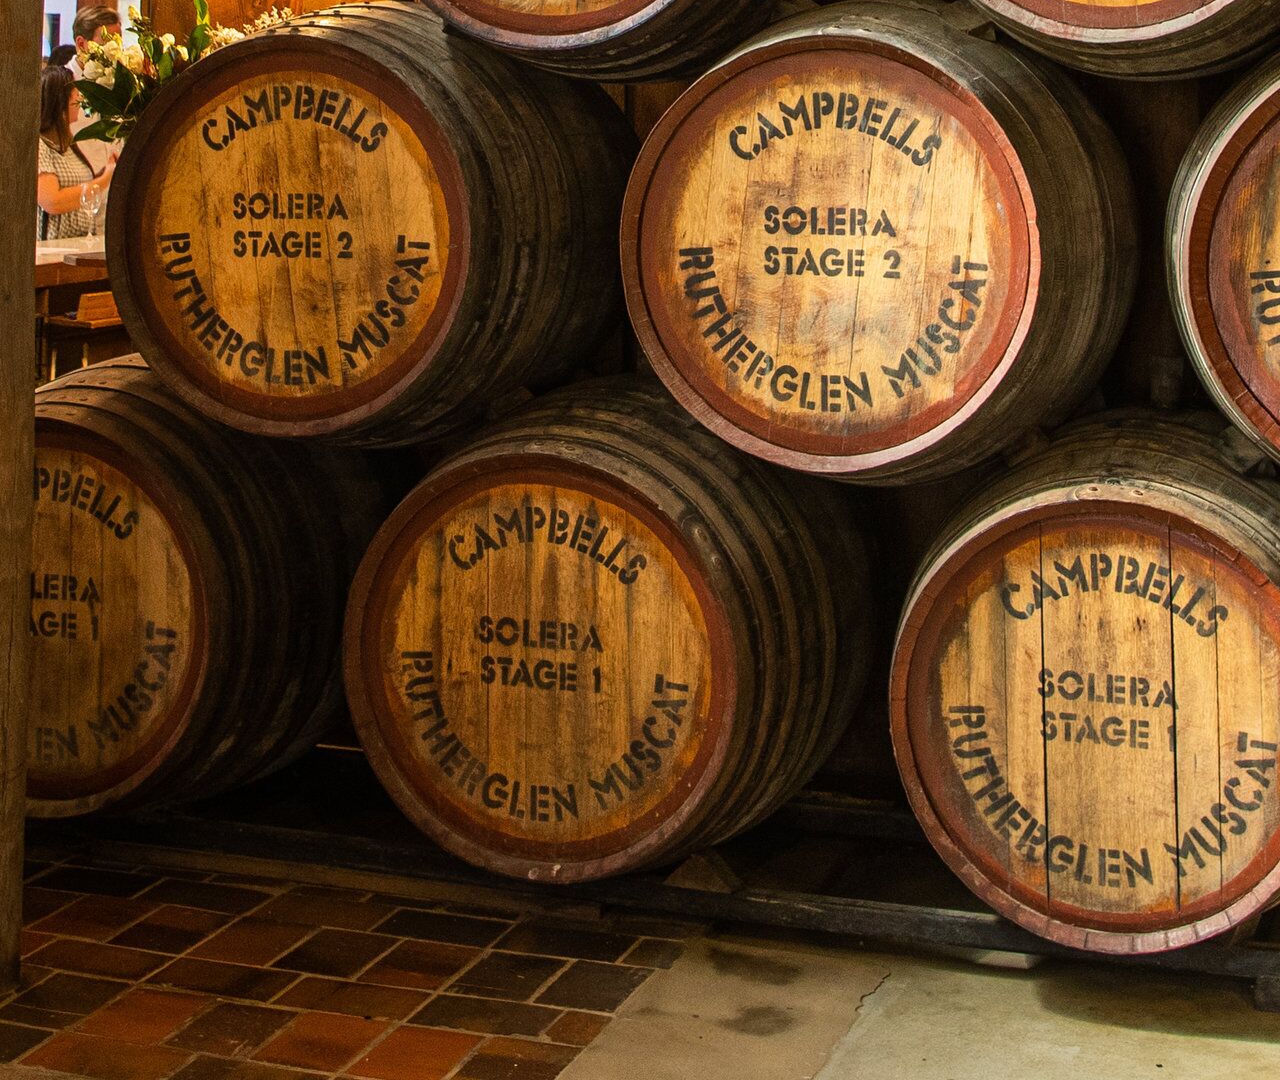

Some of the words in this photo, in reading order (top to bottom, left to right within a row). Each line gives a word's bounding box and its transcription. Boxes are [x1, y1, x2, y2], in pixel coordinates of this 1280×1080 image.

[202, 85, 389, 153] CAMPBELLS
[729, 91, 943, 167] CAMPBELLS
[233, 192, 349, 220] SOLERA
[764, 205, 897, 238] SOLERA
[233, 230, 321, 258] STAGE
[337, 231, 353, 258] 2
[764, 245, 865, 277] STAGE
[883, 249, 901, 279] 2
[159, 232, 330, 386] RUTHERGLEN
[337, 235, 431, 371] MUSCAT
[679, 246, 873, 413] RUTHERGLEN
[881, 255, 989, 397] MUSCAT
[33, 466, 140, 540] PBELLS
[448, 506, 648, 585] CAMPBELLS
[30, 572, 100, 602] LERA
[1001, 553, 1229, 638] CAMPBELLS
[478, 615, 603, 653] SOLERA
[88, 620, 177, 750] MUSCAT
[480, 656, 577, 692] STAGE
[592, 668, 601, 694] 1
[1037, 668, 1180, 710] SOLERA
[401, 651, 579, 822] RUTHERGLEN
[588, 673, 689, 810] MUSCAT
[1040, 710, 1150, 750] STAGE
[1167, 725, 1176, 753] 1
[949, 705, 1154, 889] RUTHERGLEN
[1163, 731, 1279, 878] MUSCAT
